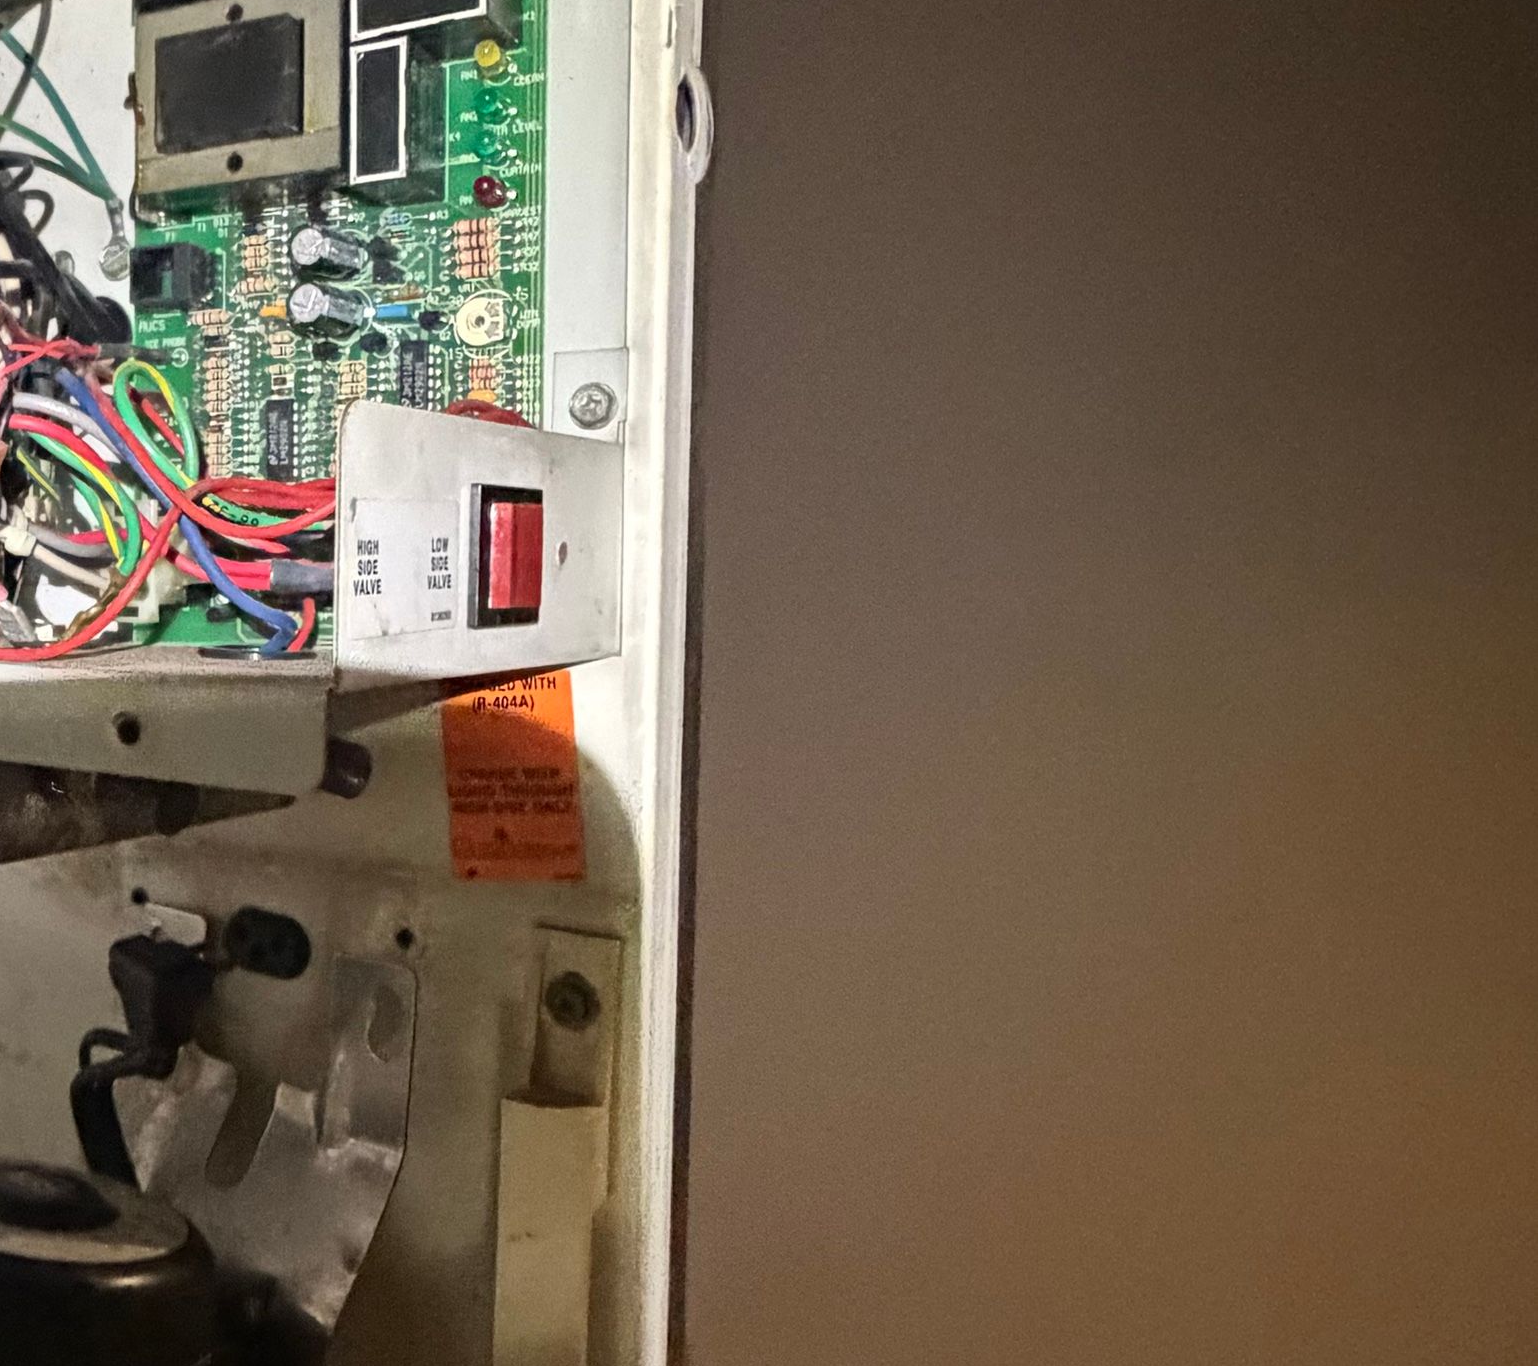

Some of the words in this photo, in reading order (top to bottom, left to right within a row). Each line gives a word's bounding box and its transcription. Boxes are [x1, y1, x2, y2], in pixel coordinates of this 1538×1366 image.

[357, 539, 379, 556] HIGH
[431, 537, 449, 553] LOW
[358, 559, 378, 576] SIDE
[431, 555, 449, 572] SIDE
[353, 578, 382, 597] VALVE
[427, 574, 451, 590] VALVE
[522, 676, 557, 691] WITH
[472, 695, 535, 713] (R-404A)
